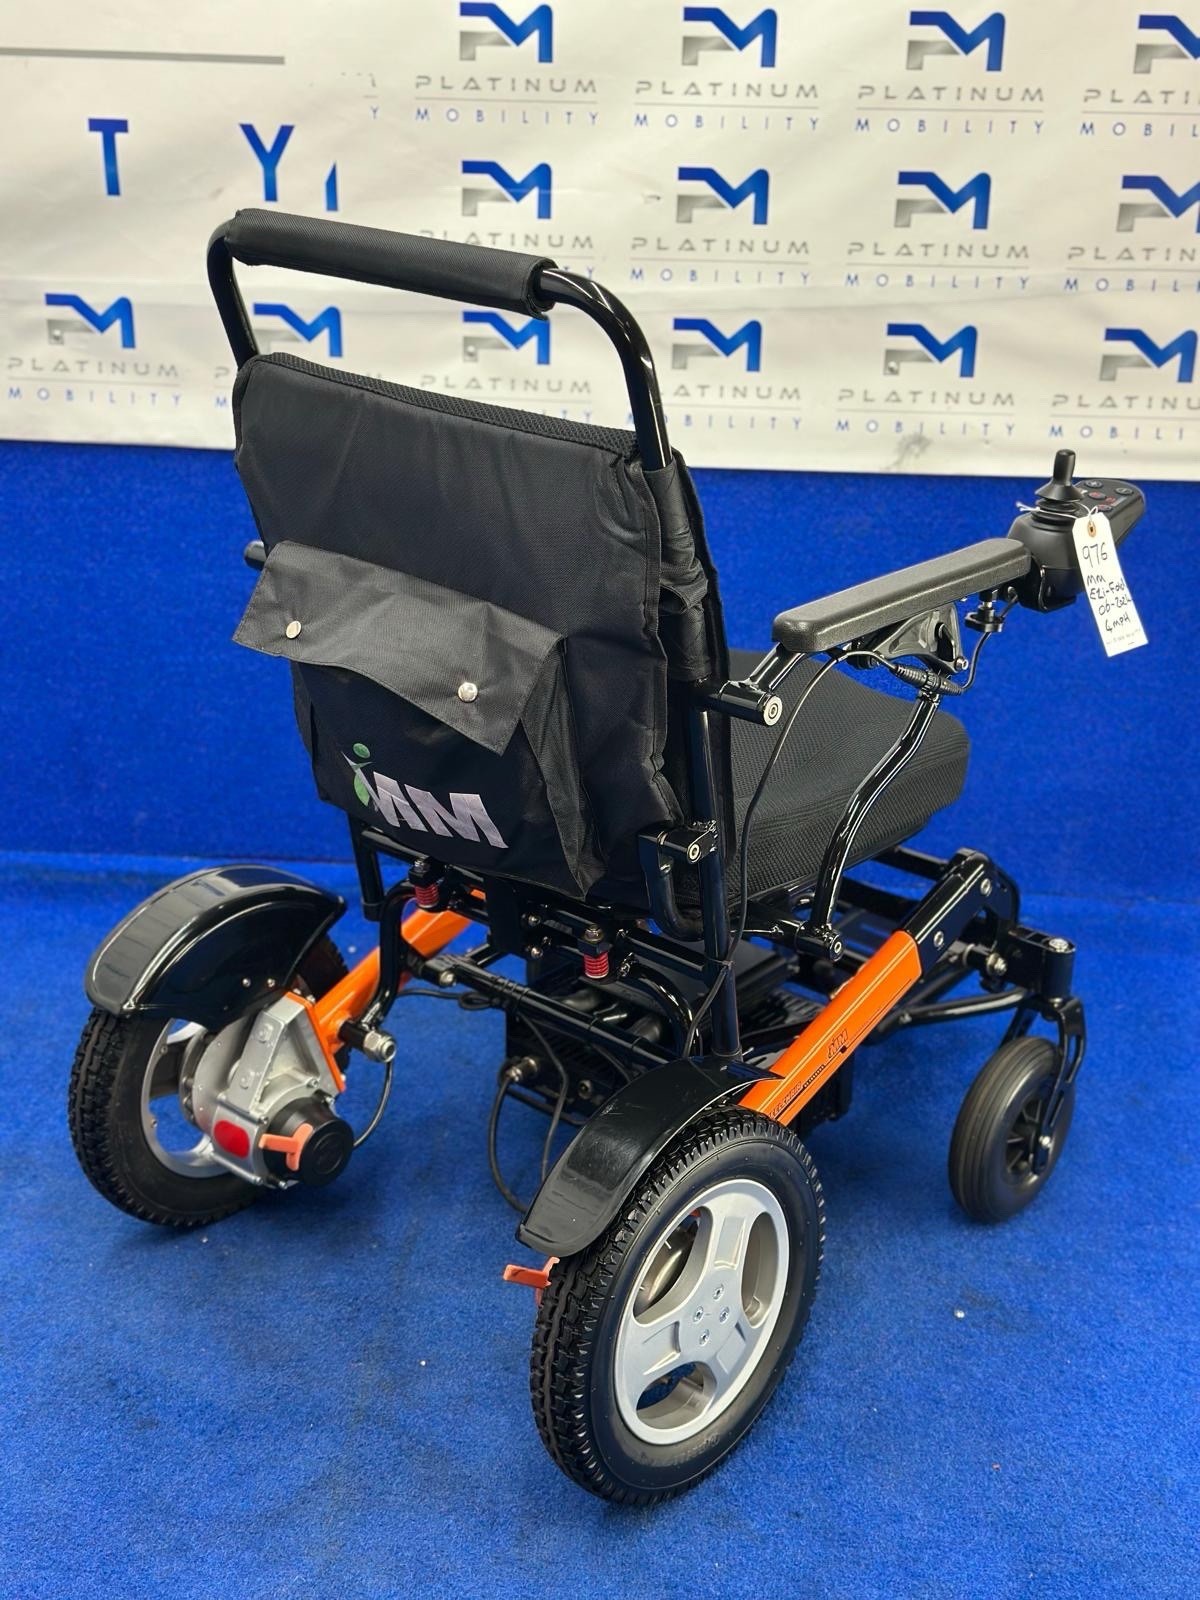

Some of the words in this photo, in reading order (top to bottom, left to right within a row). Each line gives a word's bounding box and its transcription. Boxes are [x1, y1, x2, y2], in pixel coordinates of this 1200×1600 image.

[416, 75, 596, 93] PLATINUM
[636, 81, 818, 98] PLATINUM
[858, 85, 1043, 101] PLATINUM
[1084, 89, 1200, 104] PLATI
[416, 108, 598, 125] MOBILITY
[635, 113, 818, 130] MOBILITY
[855, 118, 1043, 134] MOBILITY
[631, 237, 809, 254] PLATINUM
[848, 242, 1029, 259] PLATINUM
[630, 268, 809, 283] MOBILITY
[846, 274, 1028, 290] MOBILITY
[7, 357, 178, 378] PLATINUM
[421, 375, 591, 394] PLATINUM
[661, 384, 800, 400] ATINUM
[8, 387, 180, 405] MOBILITY
[838, 389, 1014, 406] PLATINUM
[628, 411, 801, 430] BILITY
[836, 420, 1014, 437] MOBILITY
[1082, 542, 1108, 568] 976
